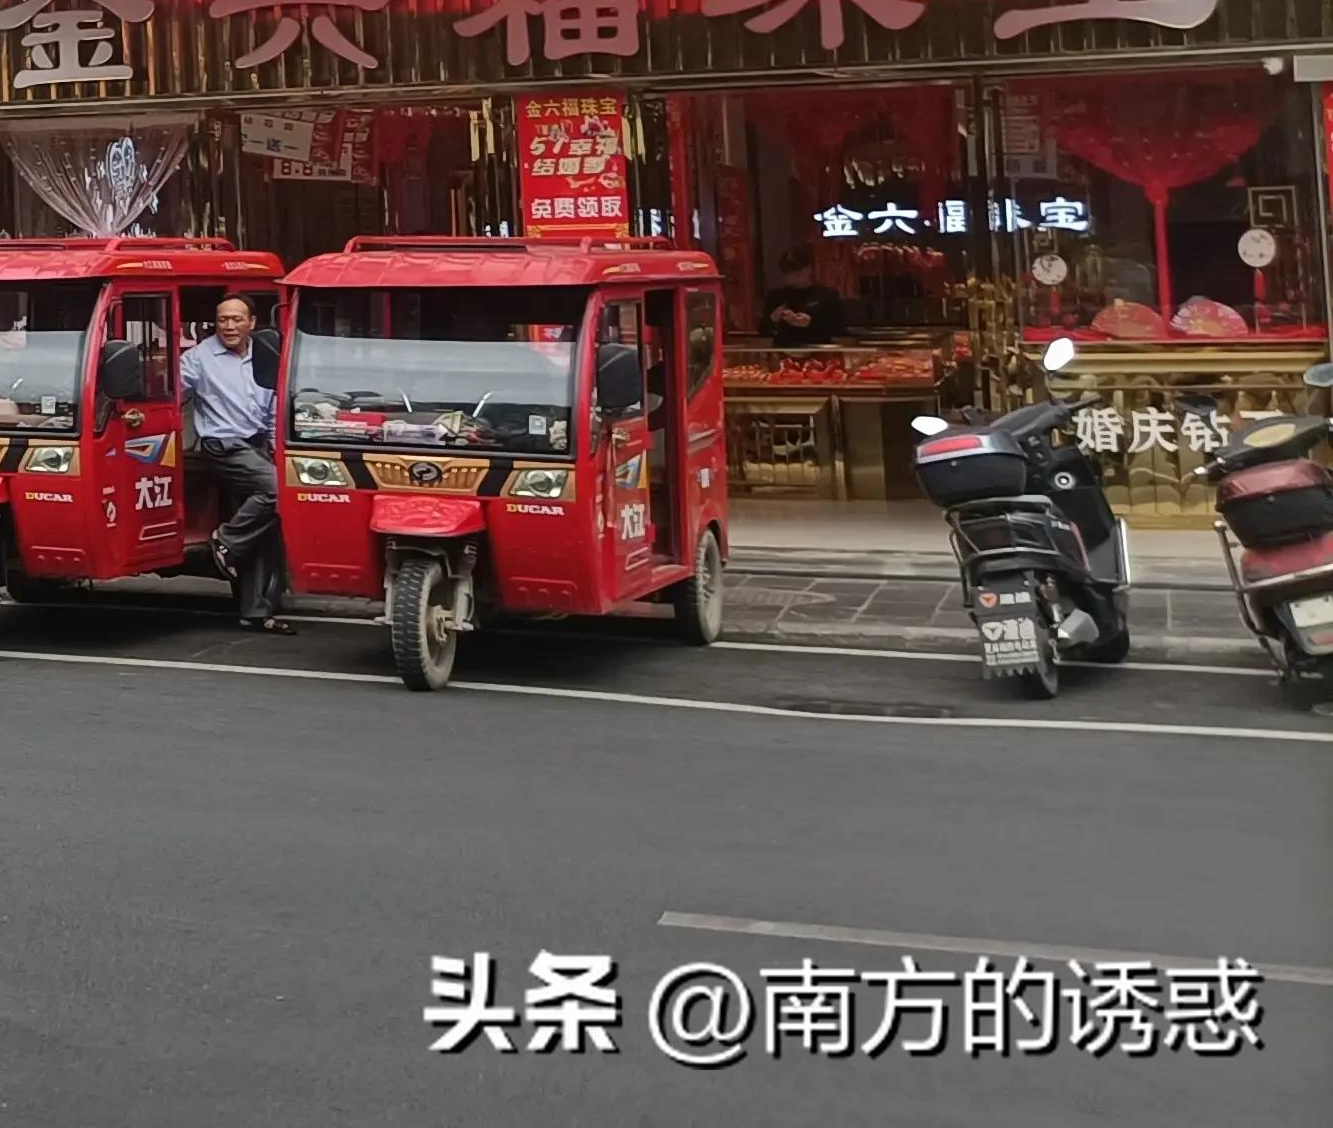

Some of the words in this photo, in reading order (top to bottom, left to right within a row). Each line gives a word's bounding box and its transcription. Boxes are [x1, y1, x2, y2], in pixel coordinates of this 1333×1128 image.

[525, 97, 618, 118] 金六福珠宝
[531, 196, 623, 219] 免费领取
[25, 491, 74, 504] DUCAR
[135, 475, 173, 511] 大江
[297, 492, 352, 504] DUCAR
[506, 503, 565, 517] DUCAR
[620, 503, 645, 541] 大江
